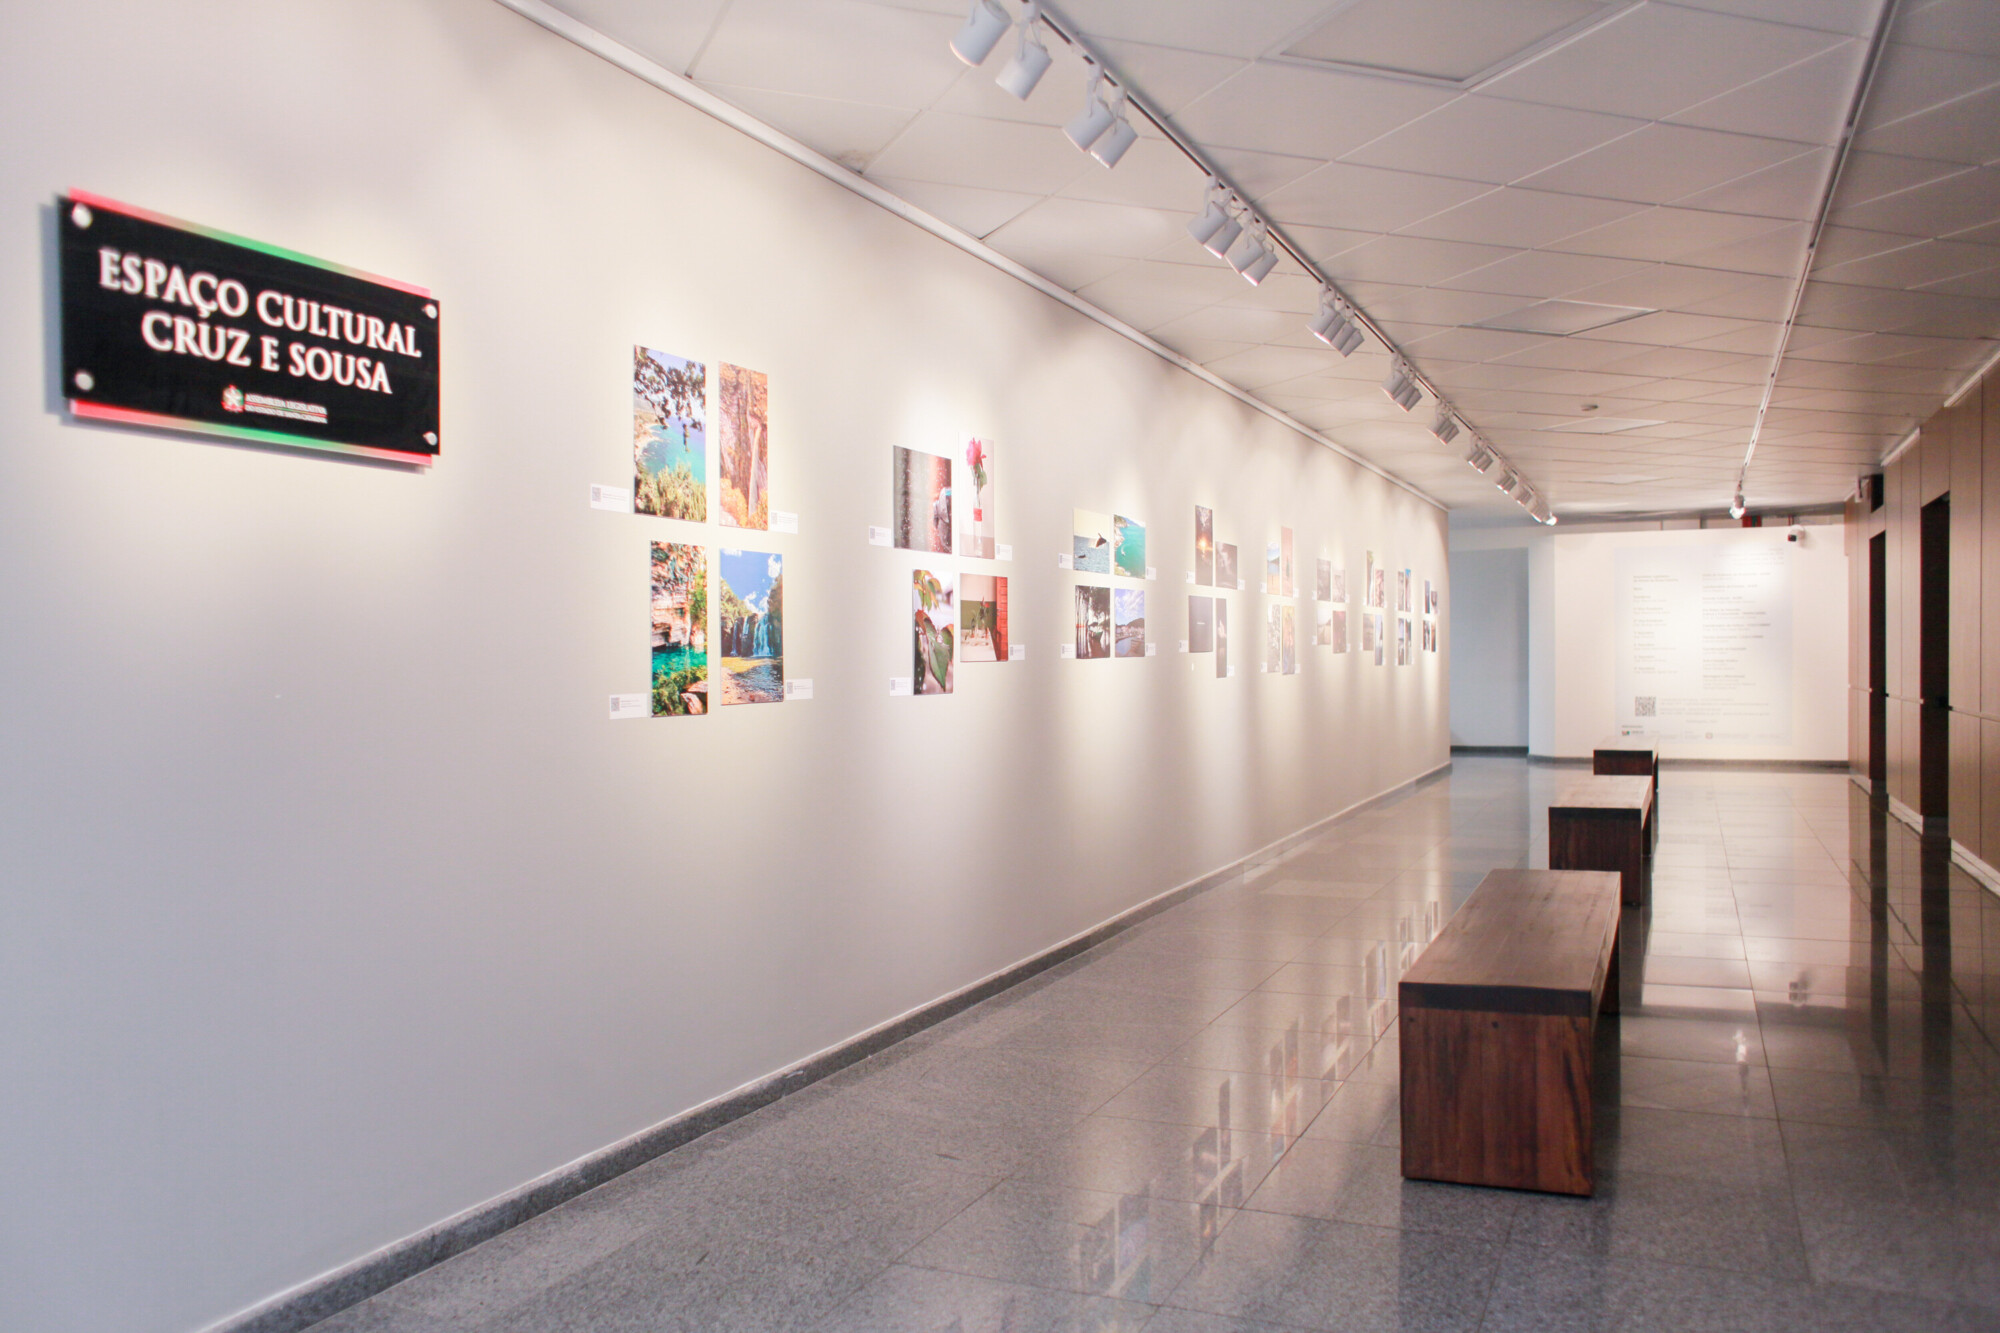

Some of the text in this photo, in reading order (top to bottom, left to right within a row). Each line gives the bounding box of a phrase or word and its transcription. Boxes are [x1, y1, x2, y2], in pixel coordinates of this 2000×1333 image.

[99, 247, 422, 358] ESPAÇO CULTURAL
[141, 310, 393, 394] CRUZ E SOUSA
